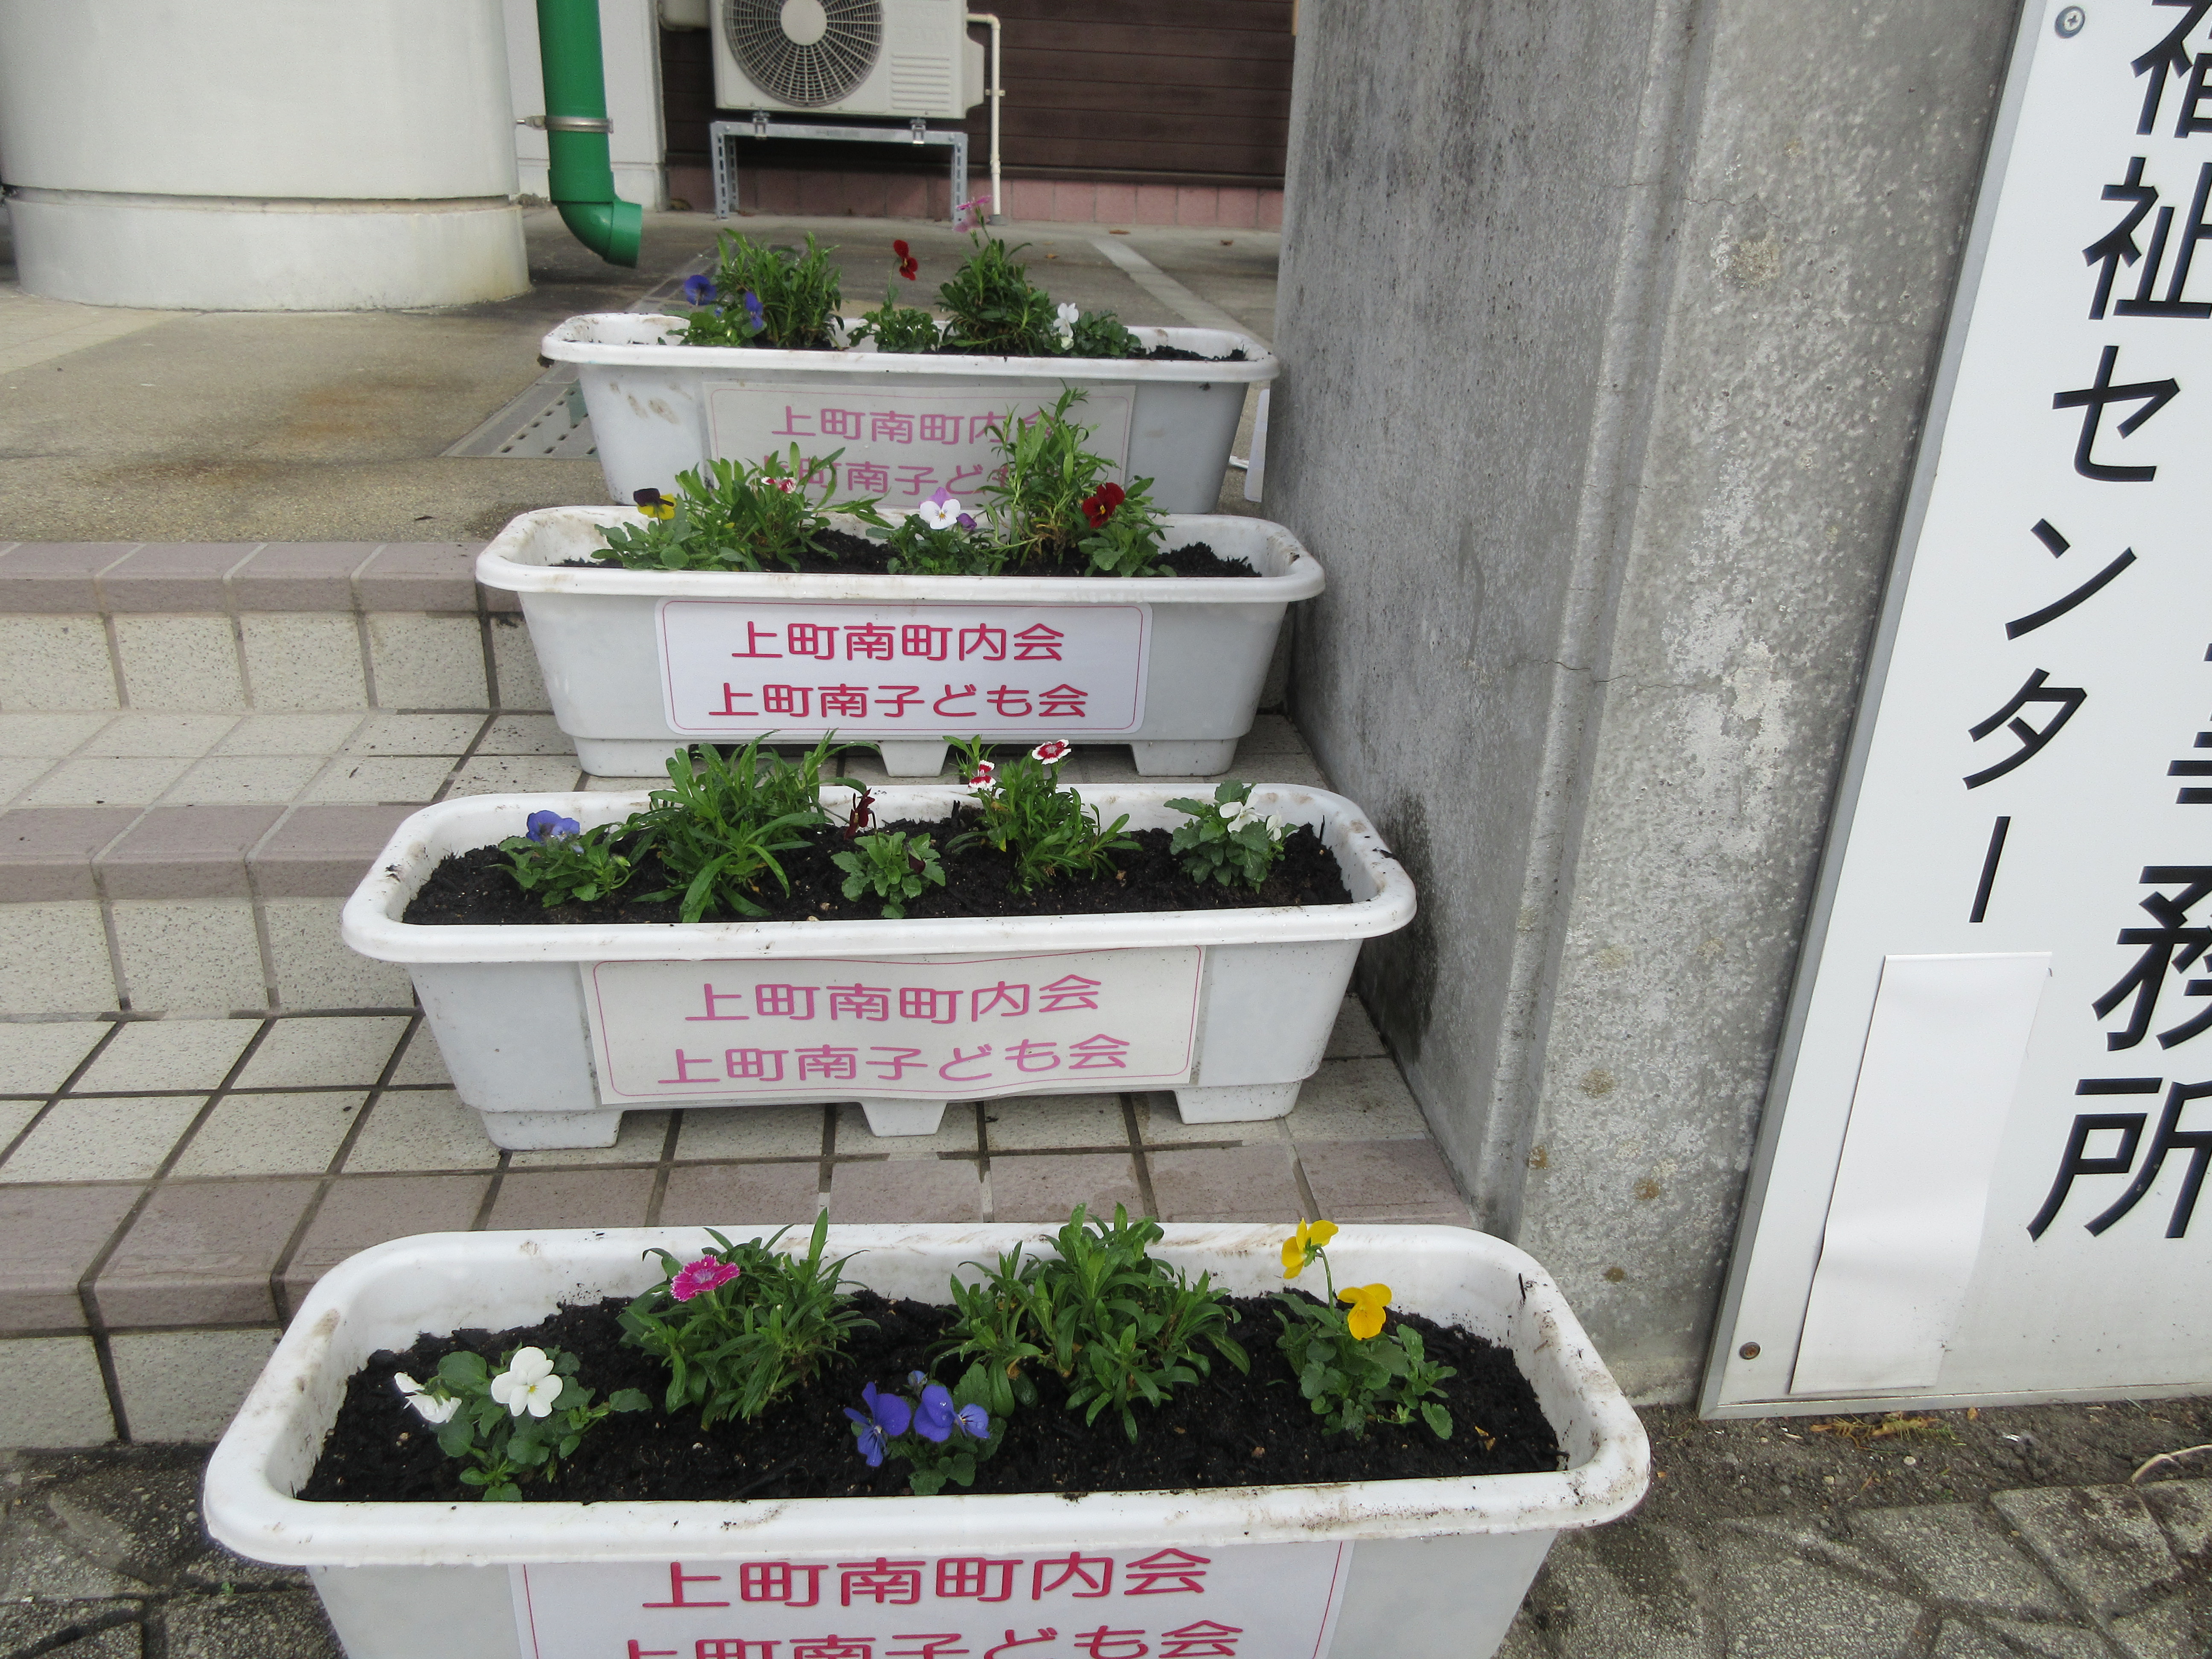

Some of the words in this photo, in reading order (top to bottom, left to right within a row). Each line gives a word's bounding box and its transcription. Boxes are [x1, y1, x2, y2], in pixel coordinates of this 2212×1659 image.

[732, 621, 1065, 662] 上町南町内会
[709, 682, 1089, 719] 上町南子ども会
[685, 974, 1102, 1025] 上町南町内会
[658, 1033, 1130, 1084] 上町南子ども会
[642, 1548, 1212, 1609] 上町南町内会
